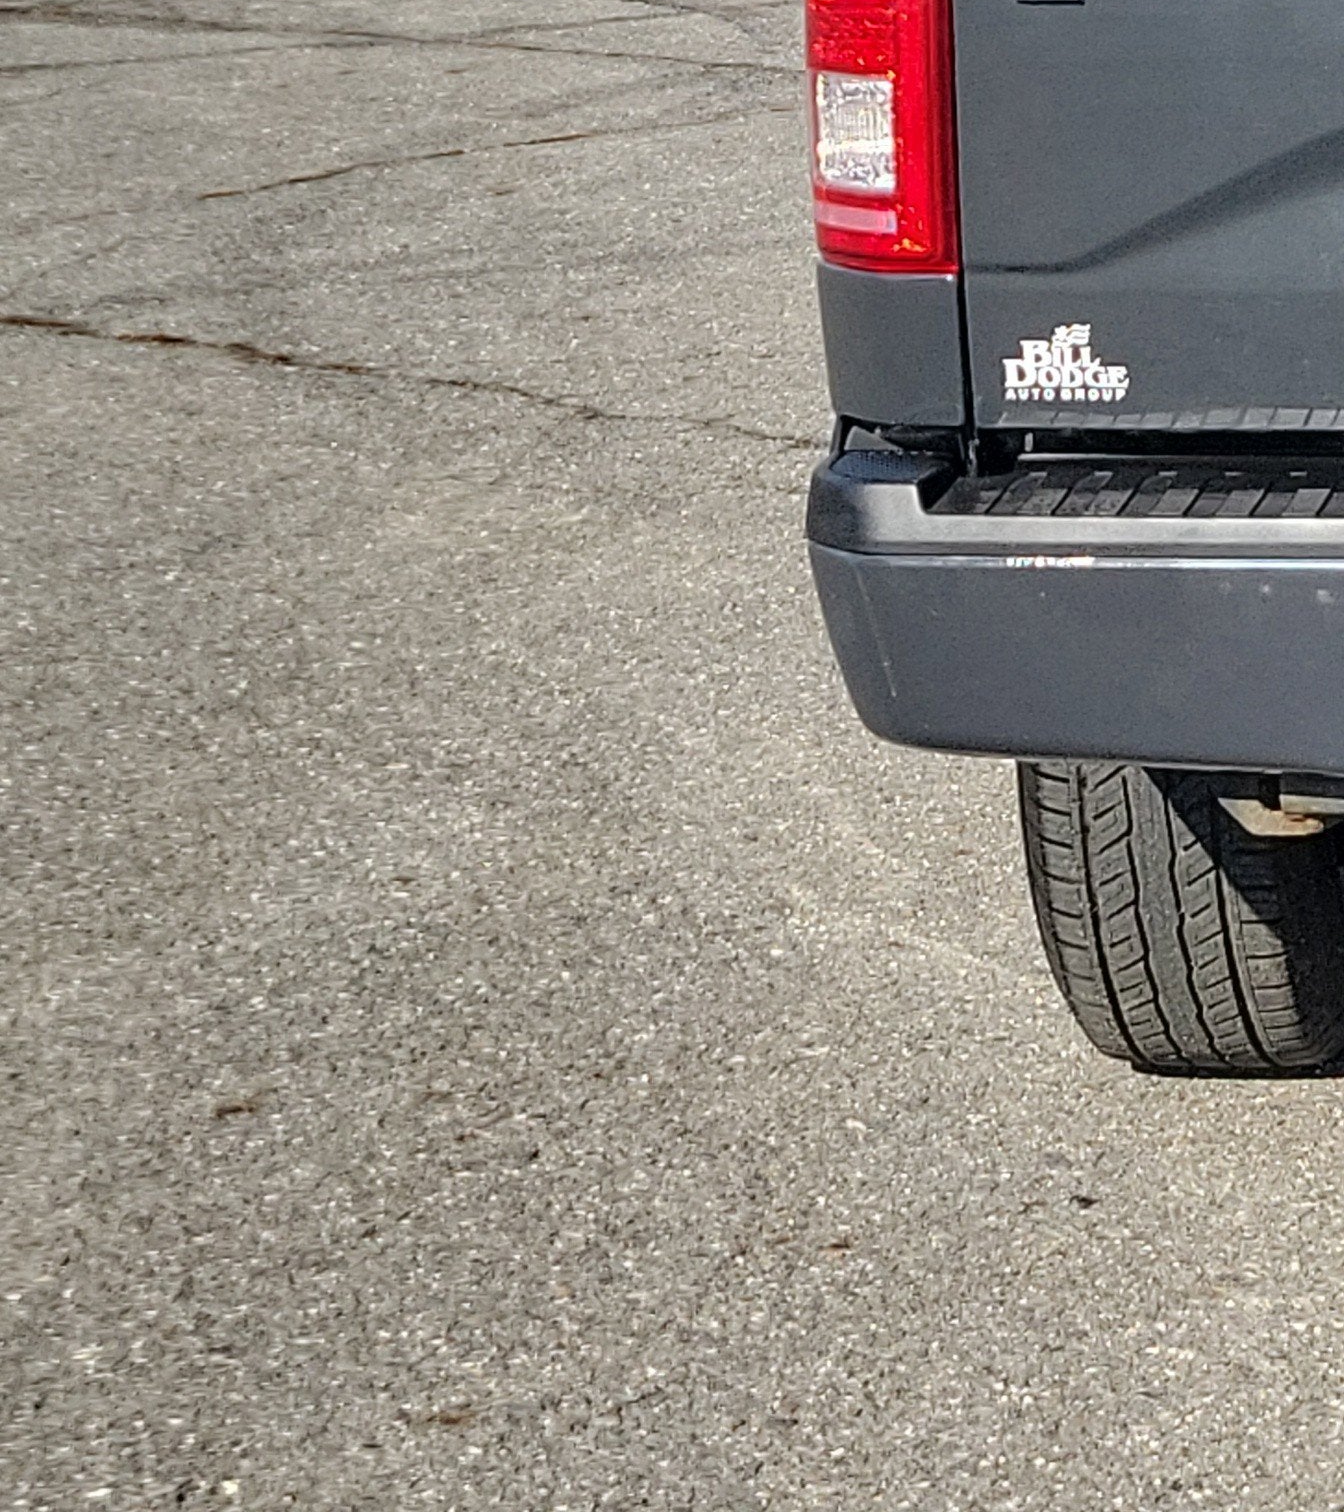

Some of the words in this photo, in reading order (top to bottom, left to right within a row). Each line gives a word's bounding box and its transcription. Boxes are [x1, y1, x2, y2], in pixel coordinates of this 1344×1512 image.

[1019, 340, 1101, 369] BILL
[1002, 358, 1130, 388] DODGE
[1004, 389, 1055, 402] AUTO
[1060, 389, 1126, 402] GROUP
